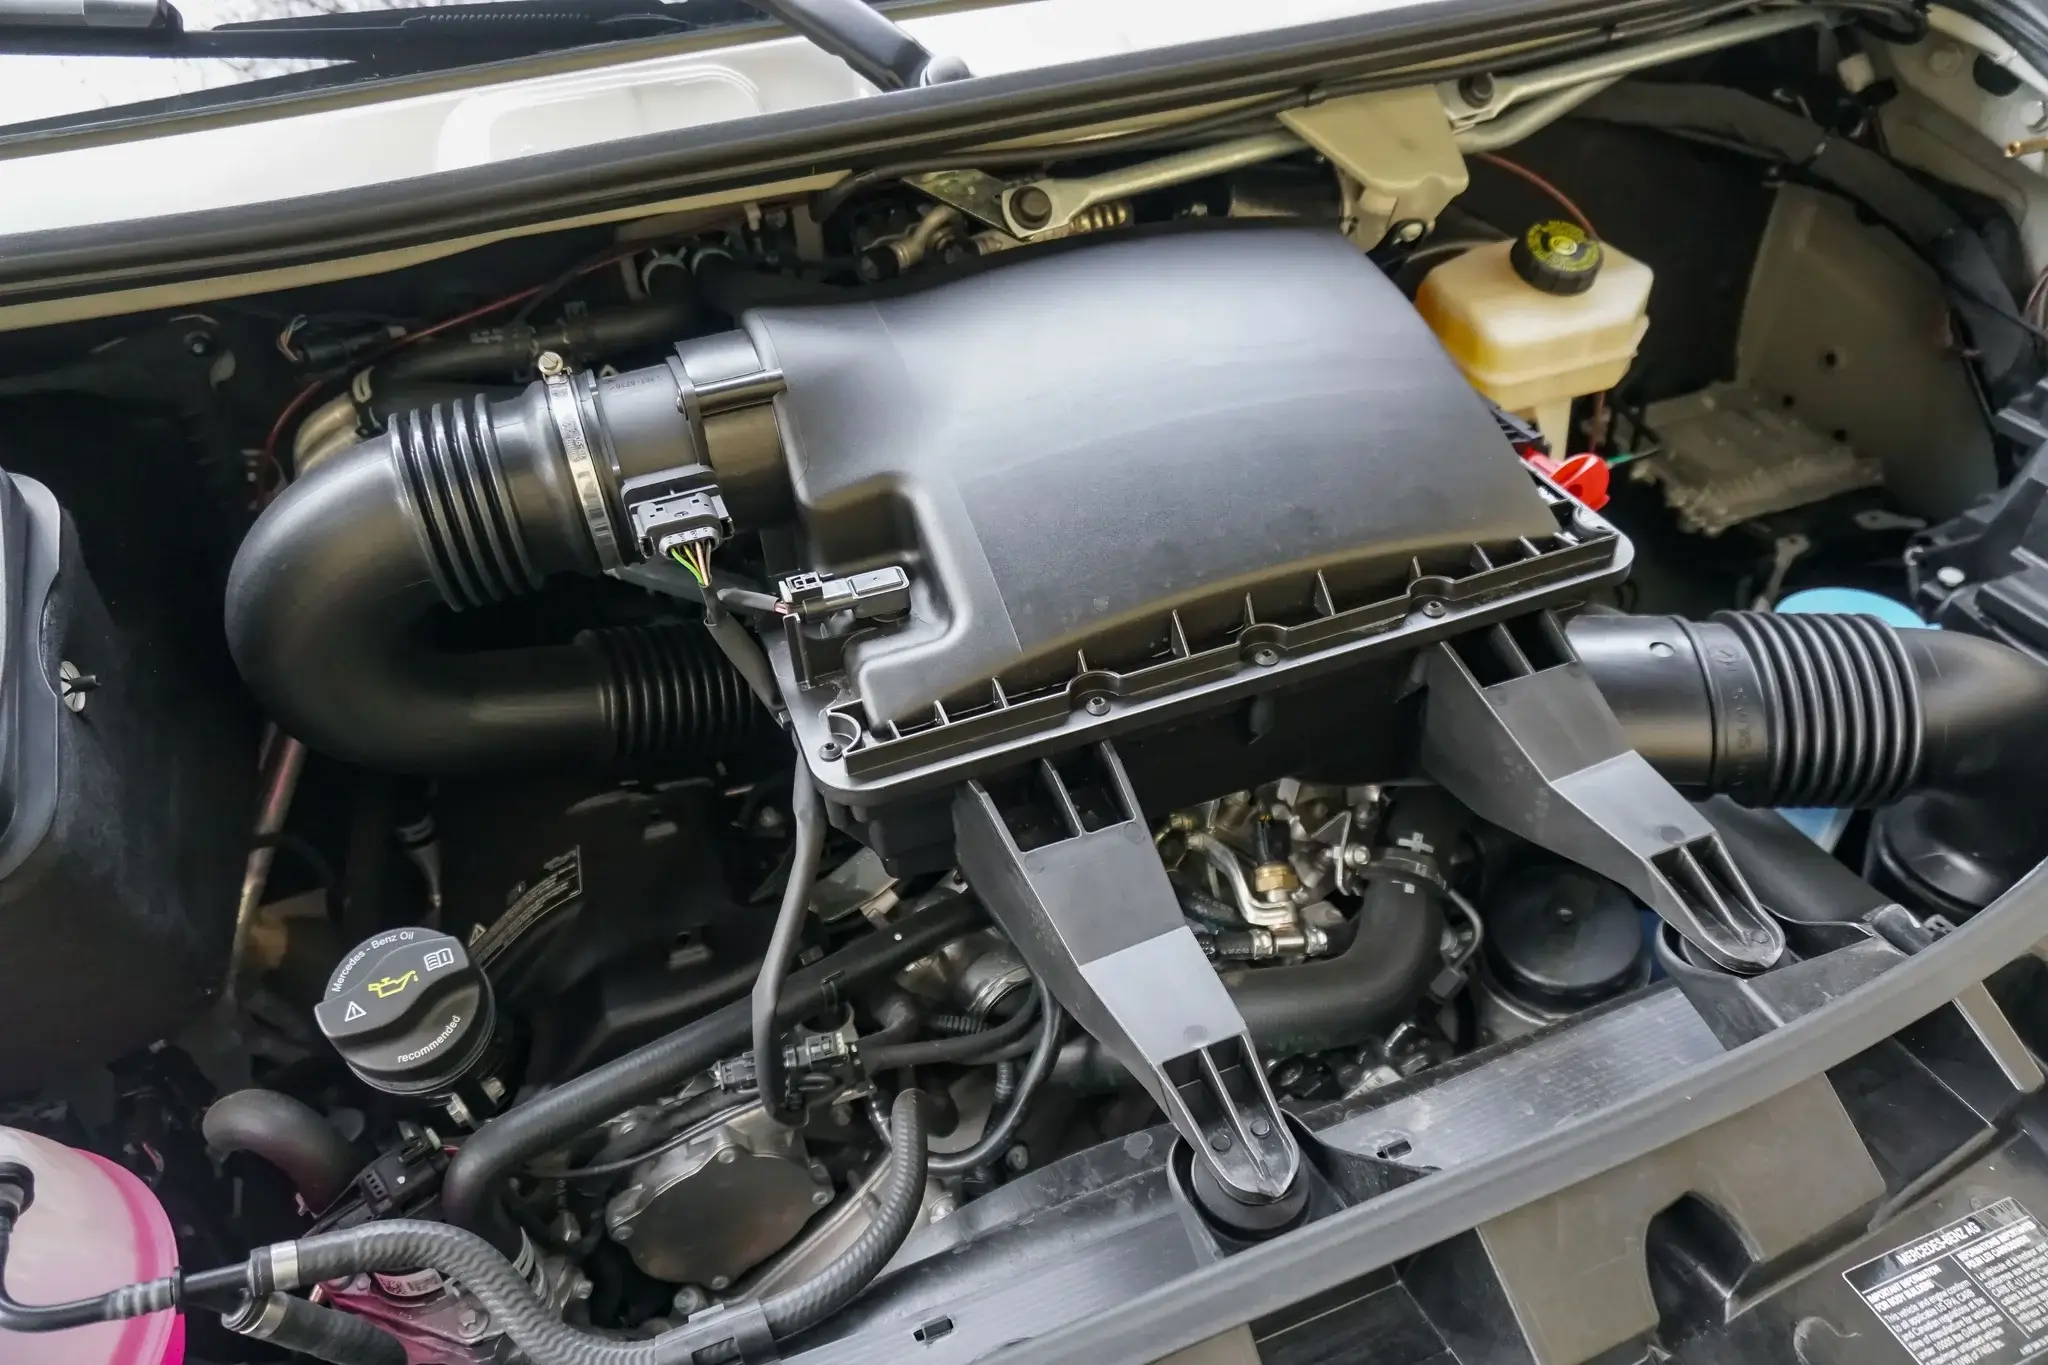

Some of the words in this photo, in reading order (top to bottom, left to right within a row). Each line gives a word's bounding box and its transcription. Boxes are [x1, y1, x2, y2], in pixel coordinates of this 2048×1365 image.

[332, 951, 366, 992] Mercedes
[371, 934, 397, 950] Benz
[400, 931, 414, 941] Oil
[397, 1015, 461, 1063] recommended
[1896, 1227, 1968, 1266] MERCEDES-BENZ
[1963, 1221, 1981, 1236] AG
[1866, 1282, 1904, 1304] IMPORTANT
[1899, 1264, 1942, 1288] INFORMATION
[1874, 1300, 1891, 1312] FOR
[1886, 1293, 1908, 1307] BODY
[1884, 1312, 1900, 1323] This
[1896, 1303, 1920, 1317] vehicle
[1916, 1298, 1931, 1308] and
[1927, 1290, 1950, 1305] engine
[1944, 1279, 1972, 1295] conform
[1892, 1324, 1903, 1333] to
[1934, 1302, 1948, 1312] US
[1955, 1289, 1976, 1302] CARB
[1900, 1330, 1916, 1341] and
